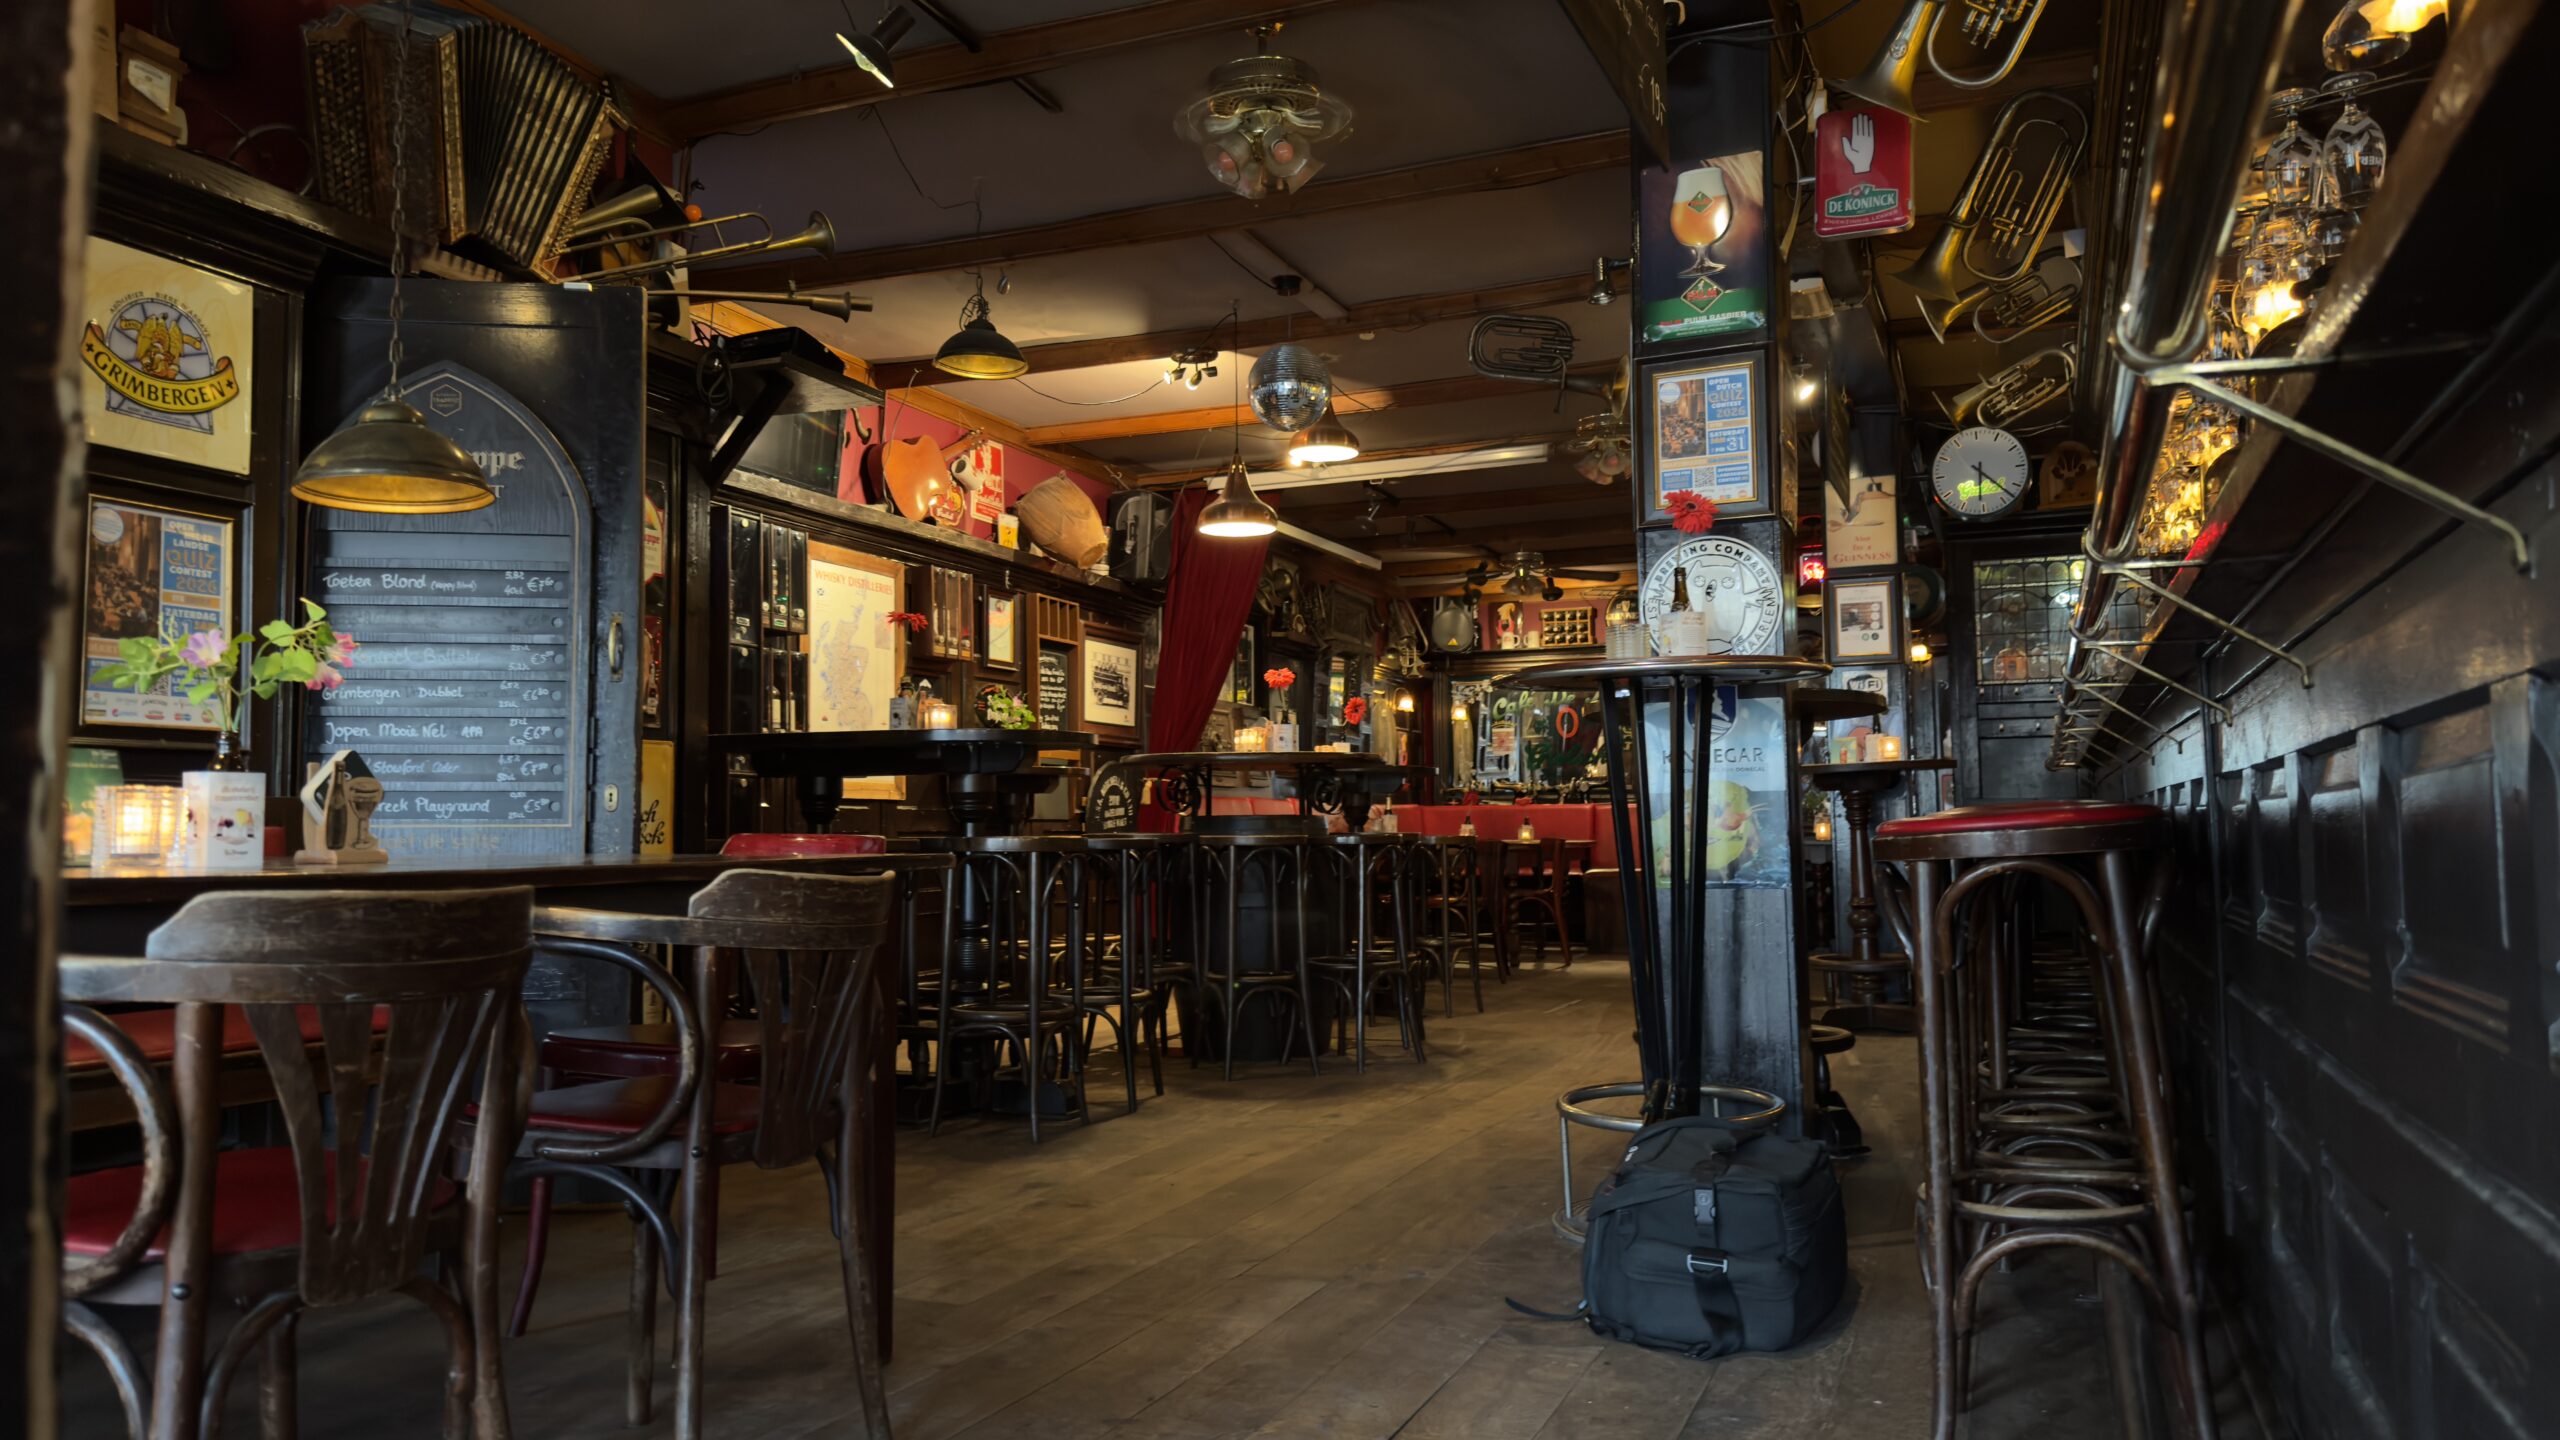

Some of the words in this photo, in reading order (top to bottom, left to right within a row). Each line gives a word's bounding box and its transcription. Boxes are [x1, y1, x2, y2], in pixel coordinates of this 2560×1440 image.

[1828, 199, 1843, 213] DE
[1845, 192, 1895, 212] KONINCK
[1684, 315, 1708, 325] PUUR
[1709, 311, 1747, 322] RASBIER
[94, 350, 225, 407] GRIMBERGEN
[1708, 377, 1730, 386] OPEN
[1716, 382, 1743, 391] DUTCH
[1708, 389, 1745, 404] QUIZ
[1711, 400, 1742, 409] CONTEST
[1726, 437, 1746, 451] 31
[165, 548, 217, 571] QUIZ
[1654, 544, 1709, 585] BREWING
[1714, 543, 1771, 584] COMPANY
[1833, 551, 1891, 563] GUINNESS
[169, 565, 213, 579] CONTEST
[322, 571, 372, 590] Toeter
[380, 572, 427, 589] Blond
[813, 568, 846, 585] WHISKY
[1737, 596, 1777, 656] HAARLEM
[321, 686, 401, 705] Grimbergen
[417, 685, 465, 698] Dubbel
[325, 721, 371, 745] Jopen
[378, 722, 419, 738] Mooie
[422, 722, 447, 738] Nel
[372, 758, 425, 775] Stowford
[431, 761, 460, 773] Cider
[376, 798, 409, 813] reek
[414, 797, 490, 819] Playground
